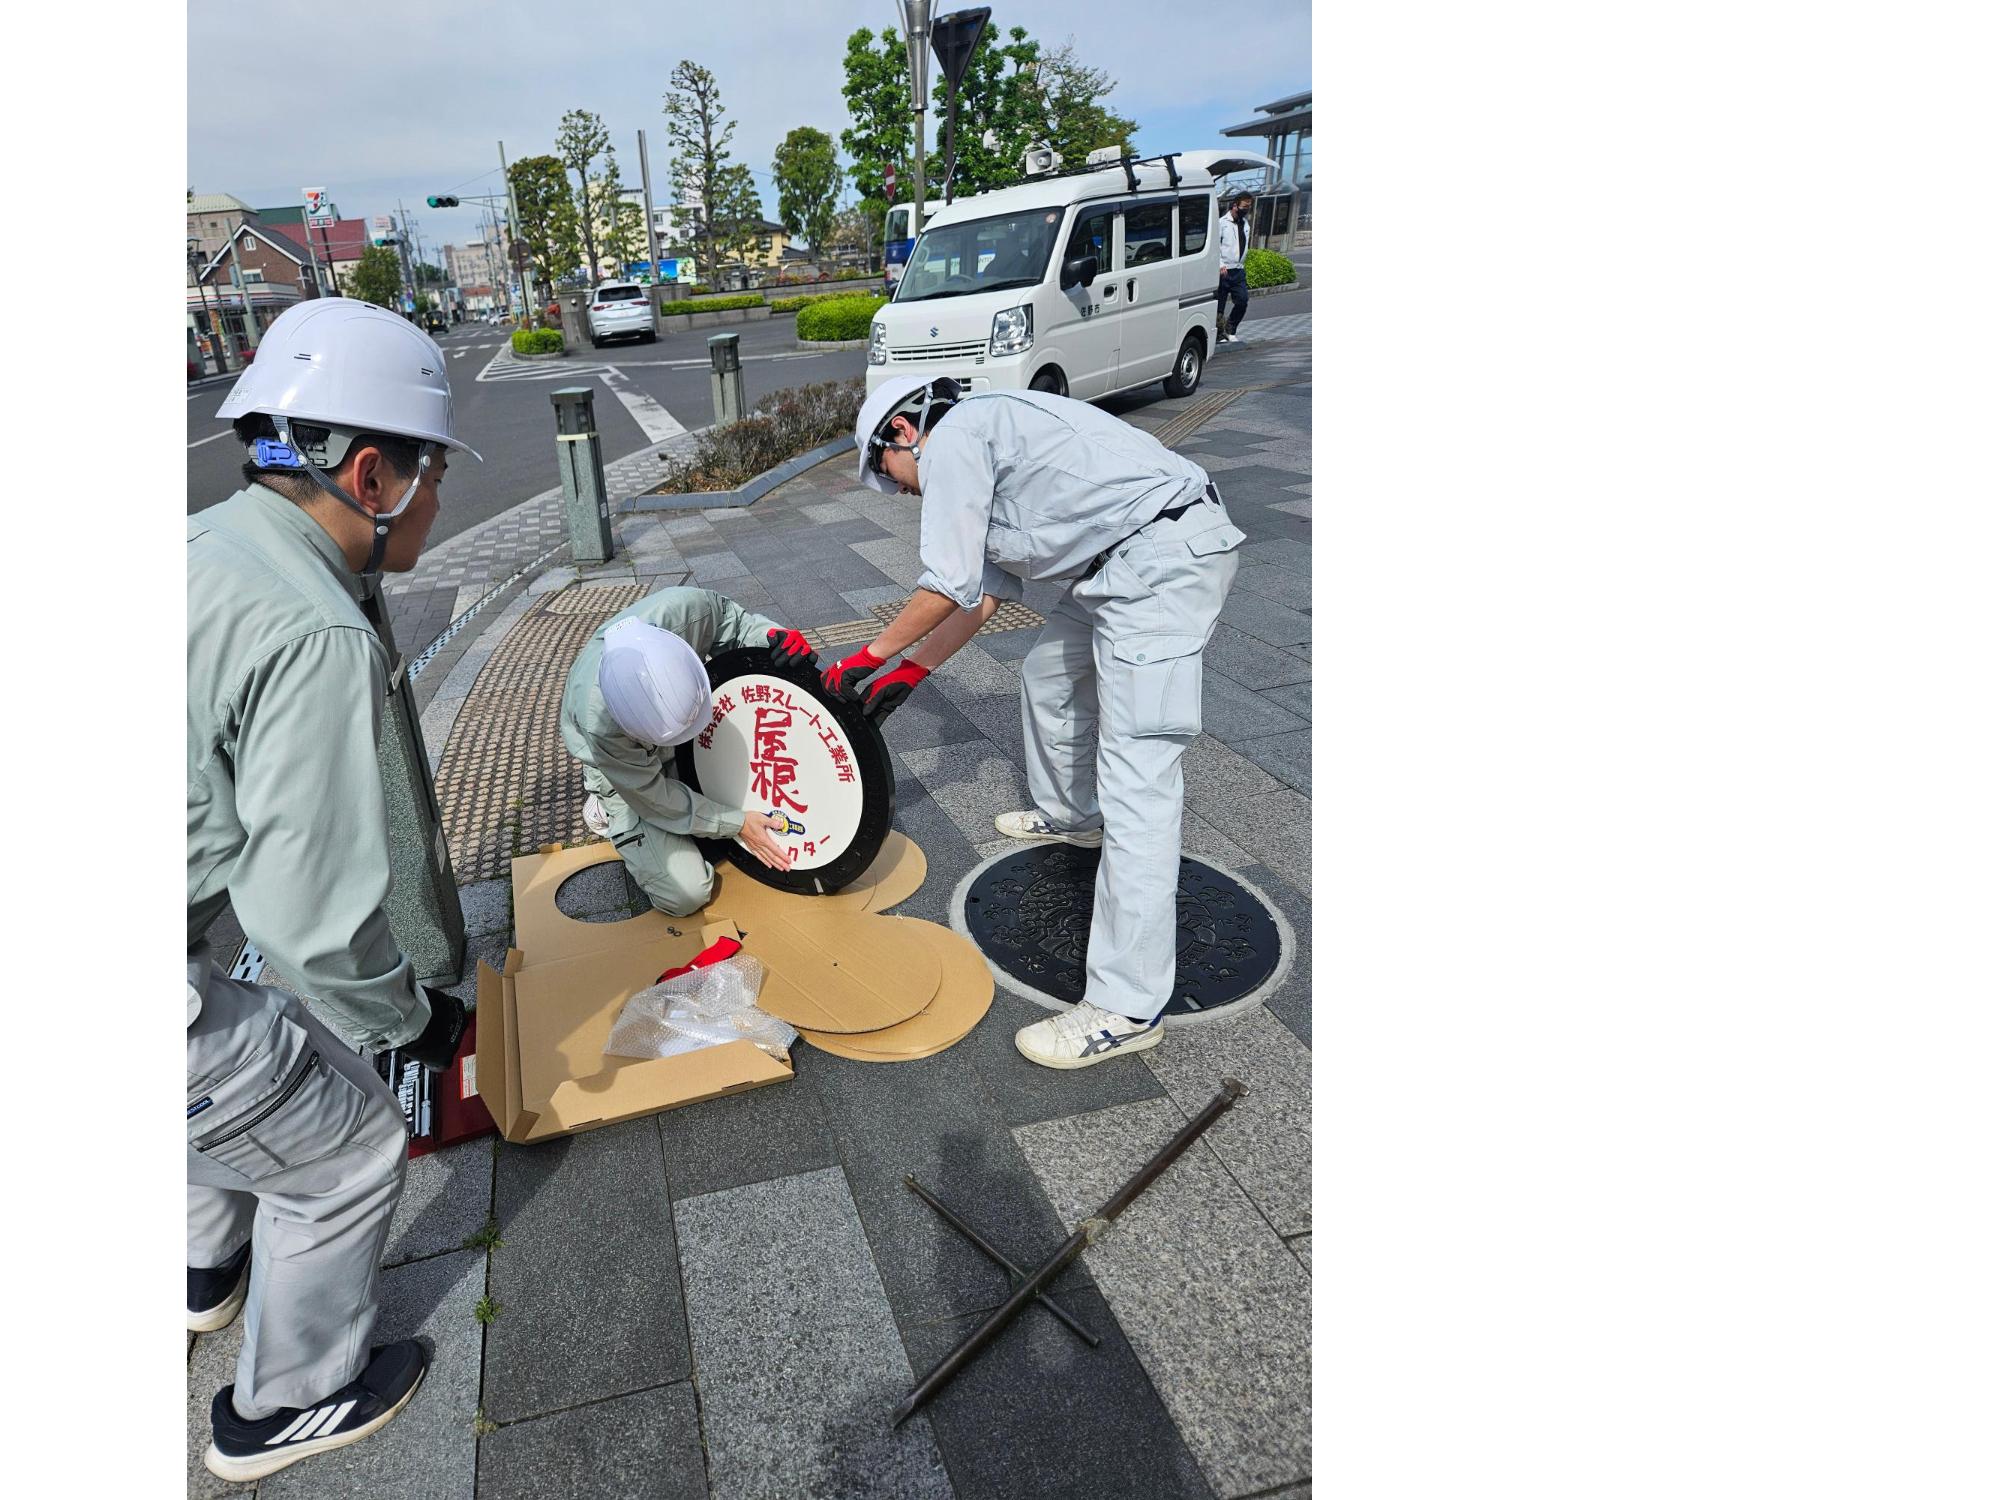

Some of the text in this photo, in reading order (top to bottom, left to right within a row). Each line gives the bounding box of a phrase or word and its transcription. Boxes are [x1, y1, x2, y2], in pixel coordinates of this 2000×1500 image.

[1080, 304, 1100, 317] 佐野市
[698, 684, 856, 783] 株式会社 佐野スレート工業所
[750, 706, 808, 814] 屋根
[788, 835, 831, 862] クター
